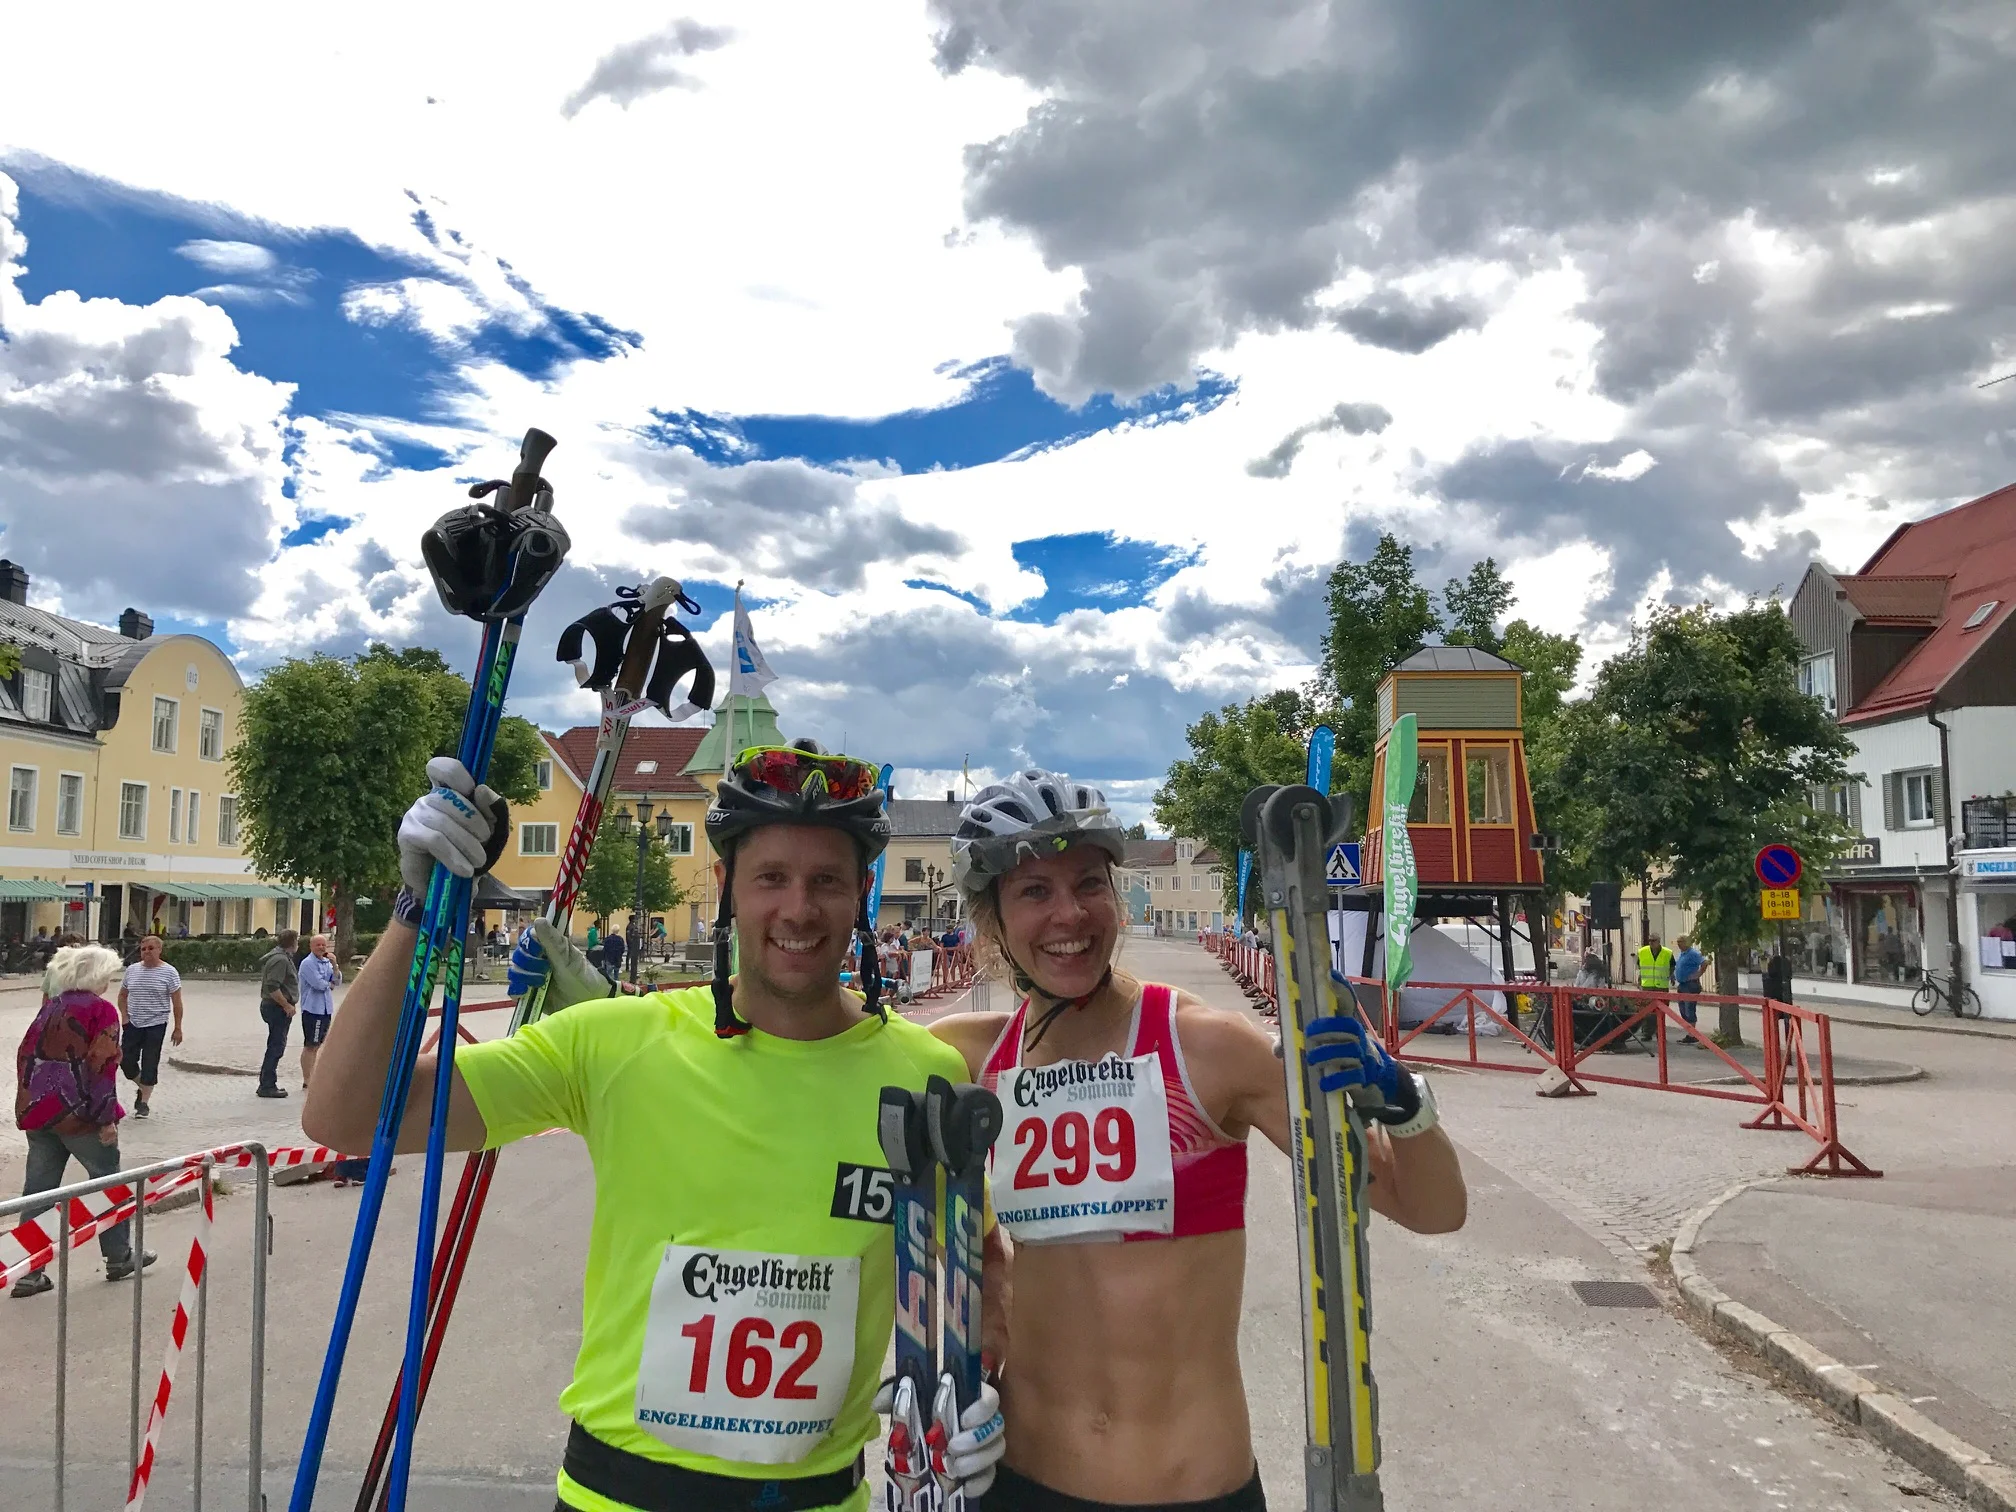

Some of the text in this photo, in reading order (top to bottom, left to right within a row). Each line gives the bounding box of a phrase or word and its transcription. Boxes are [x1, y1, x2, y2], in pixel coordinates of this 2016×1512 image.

[1767, 900, 1794, 908] (8-18)
[1013, 1055, 1135, 1107] Engelbrekt
[1066, 1081, 1136, 1103] Sommar
[1013, 1106, 1137, 1191] 299
[842, 1167, 892, 1219] 15
[997, 1198, 1168, 1225] ENGELBREKTSLOPPET
[681, 1252, 835, 1303] Engelbrekt
[754, 1290, 831, 1311] Sommar
[681, 1314, 824, 1400] 162
[638, 1408, 836, 1436] ENGELBREKTSLOPPET
